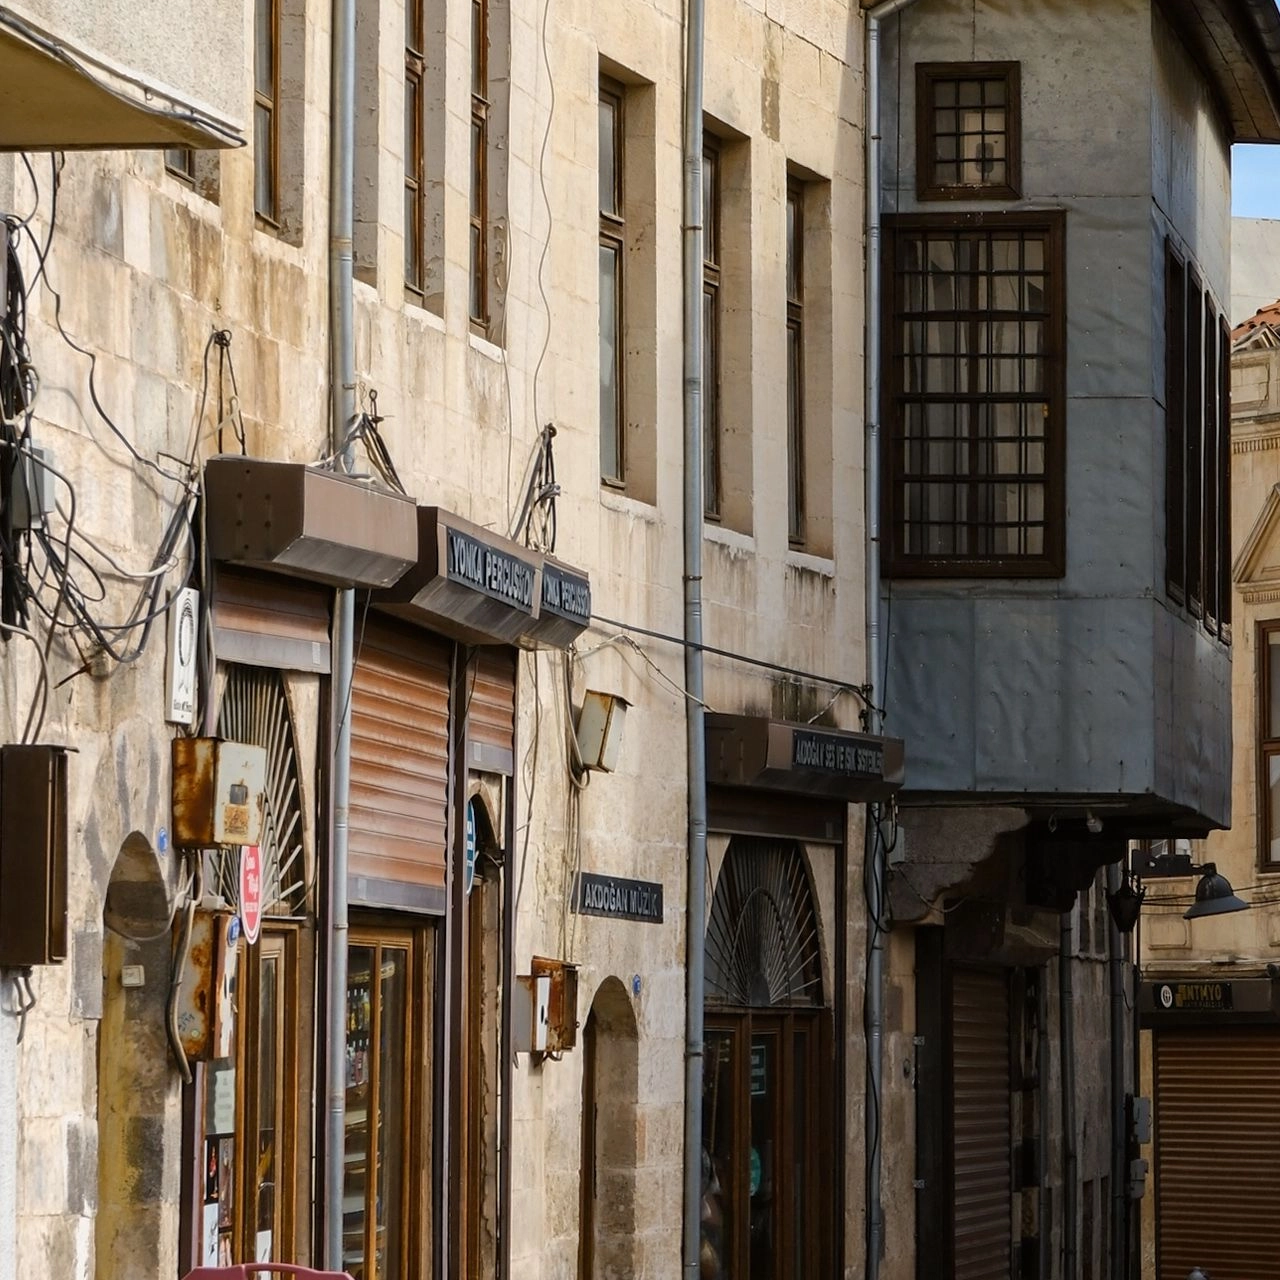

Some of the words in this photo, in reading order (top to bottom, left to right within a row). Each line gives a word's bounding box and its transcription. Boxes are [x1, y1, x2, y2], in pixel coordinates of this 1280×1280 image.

[453, 536, 483, 584] YONKA
[585, 881, 628, 913] AKDOĞAN
[629, 886, 658, 917] MÜZİK
